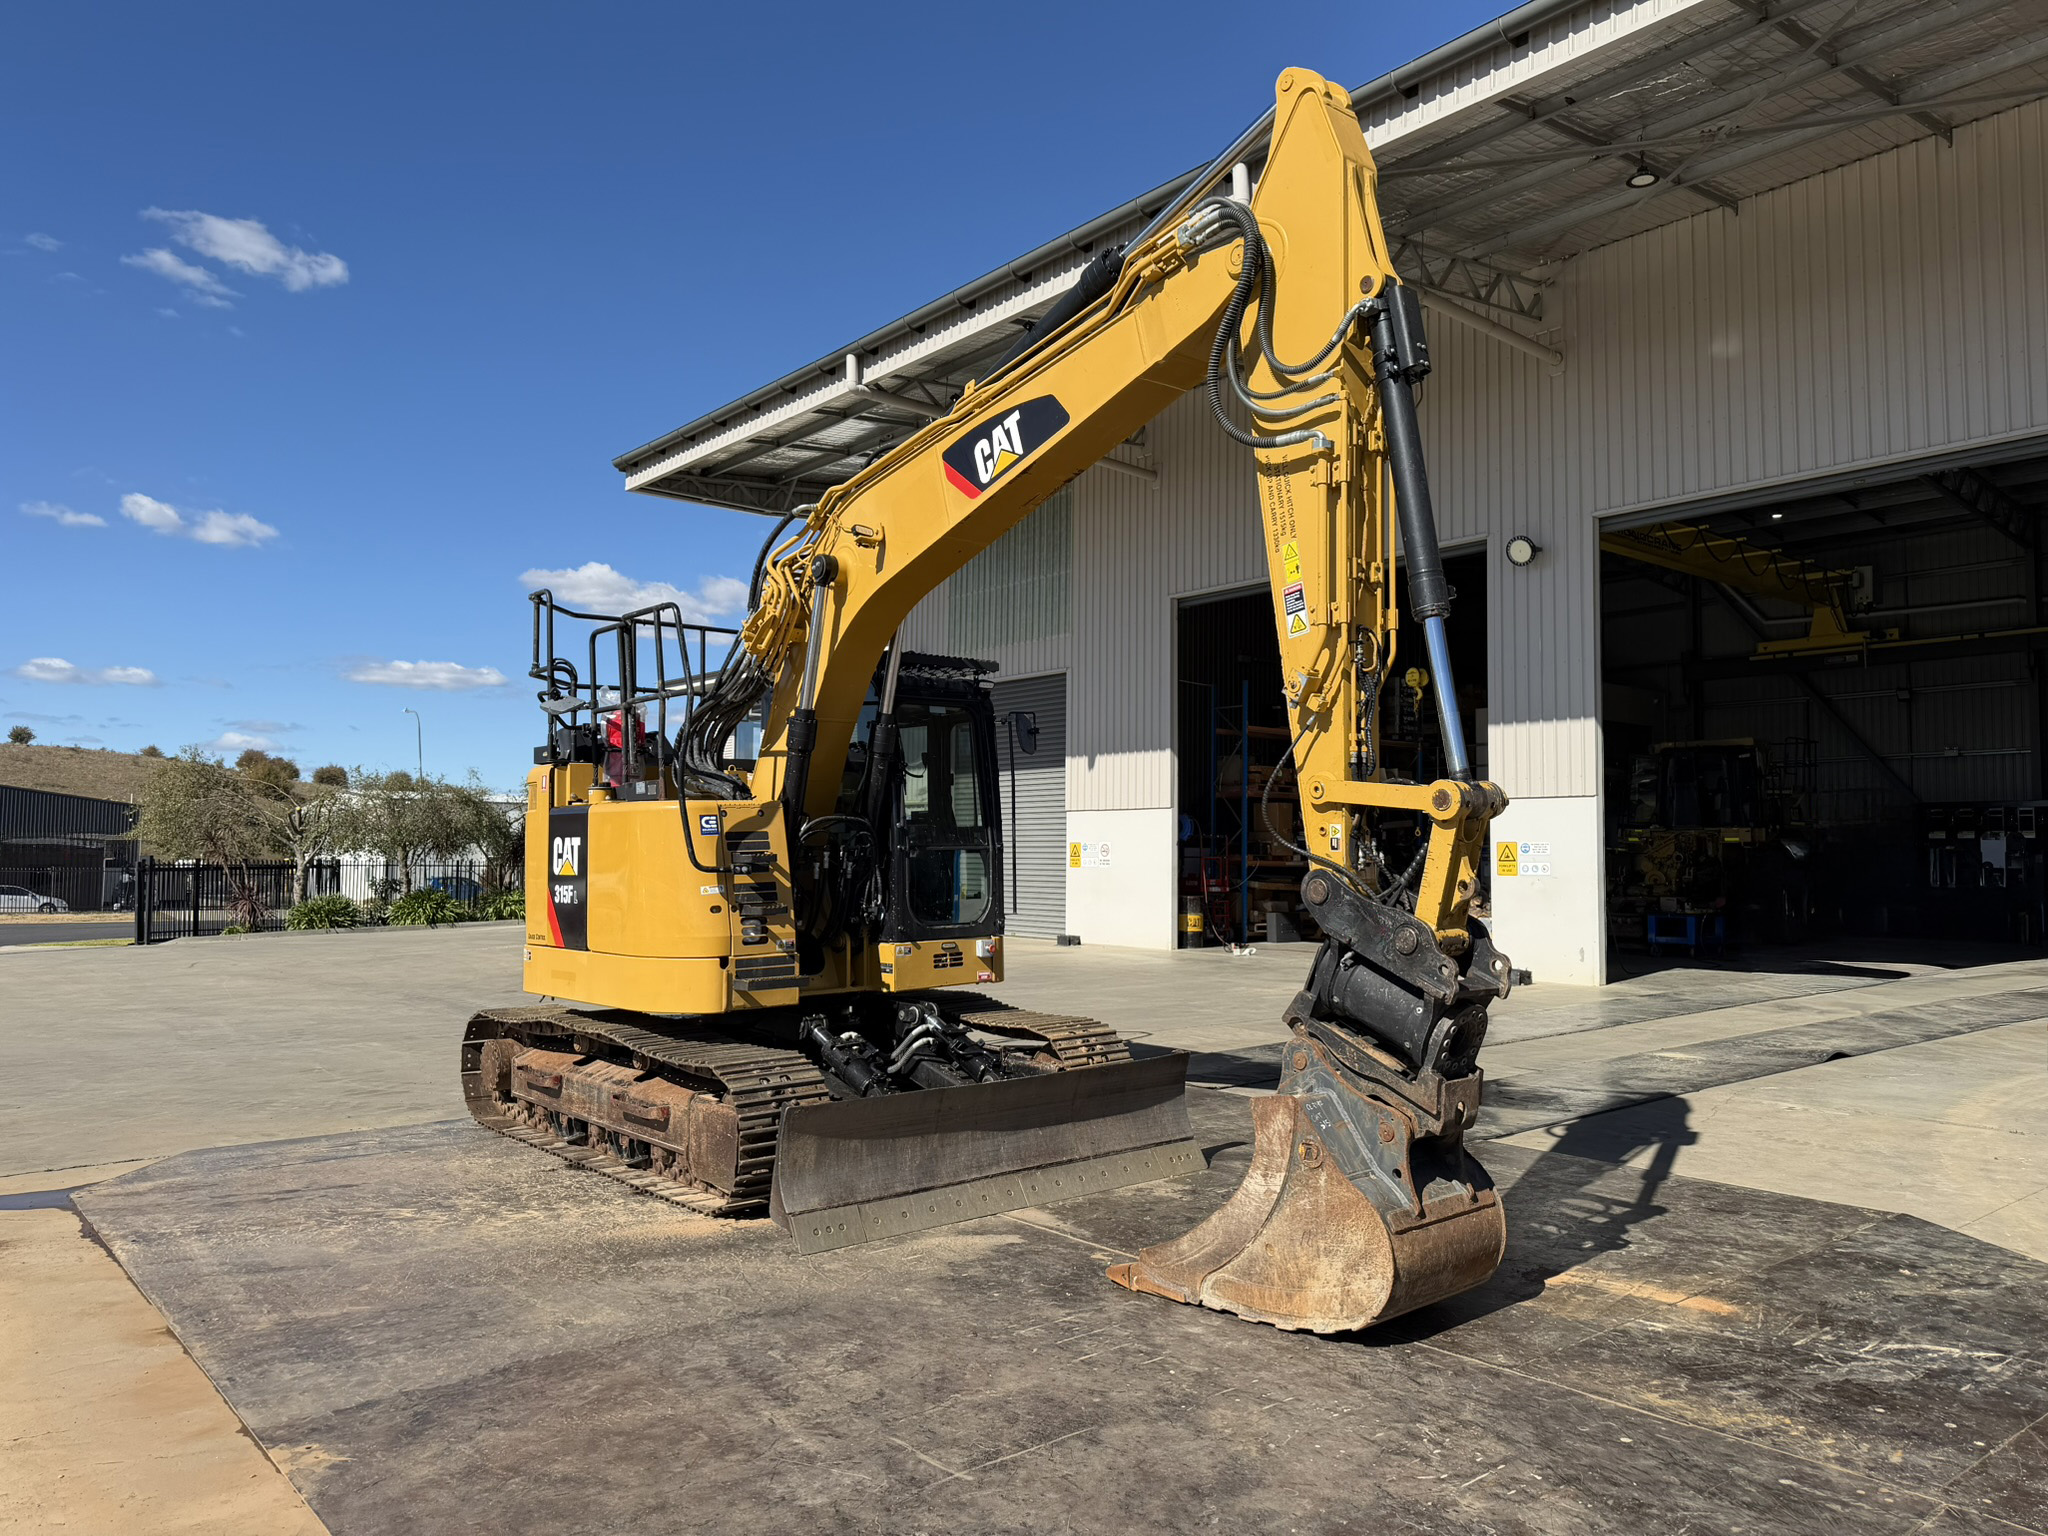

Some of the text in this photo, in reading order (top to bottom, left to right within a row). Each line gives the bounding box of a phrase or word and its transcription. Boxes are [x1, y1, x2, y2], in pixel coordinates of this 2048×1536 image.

[974, 409, 1024, 484] CAT
[1267, 485, 1275, 500] AND
[1274, 465, 1285, 509] STATIONARY
[1283, 471, 1292, 496] QUICK
[1269, 502, 1278, 527] CARRY
[1286, 496, 1295, 521] HITCH
[1288, 520, 1297, 539] ONLY
[552, 836, 581, 876] CAT
[554, 884, 574, 904] 315F
